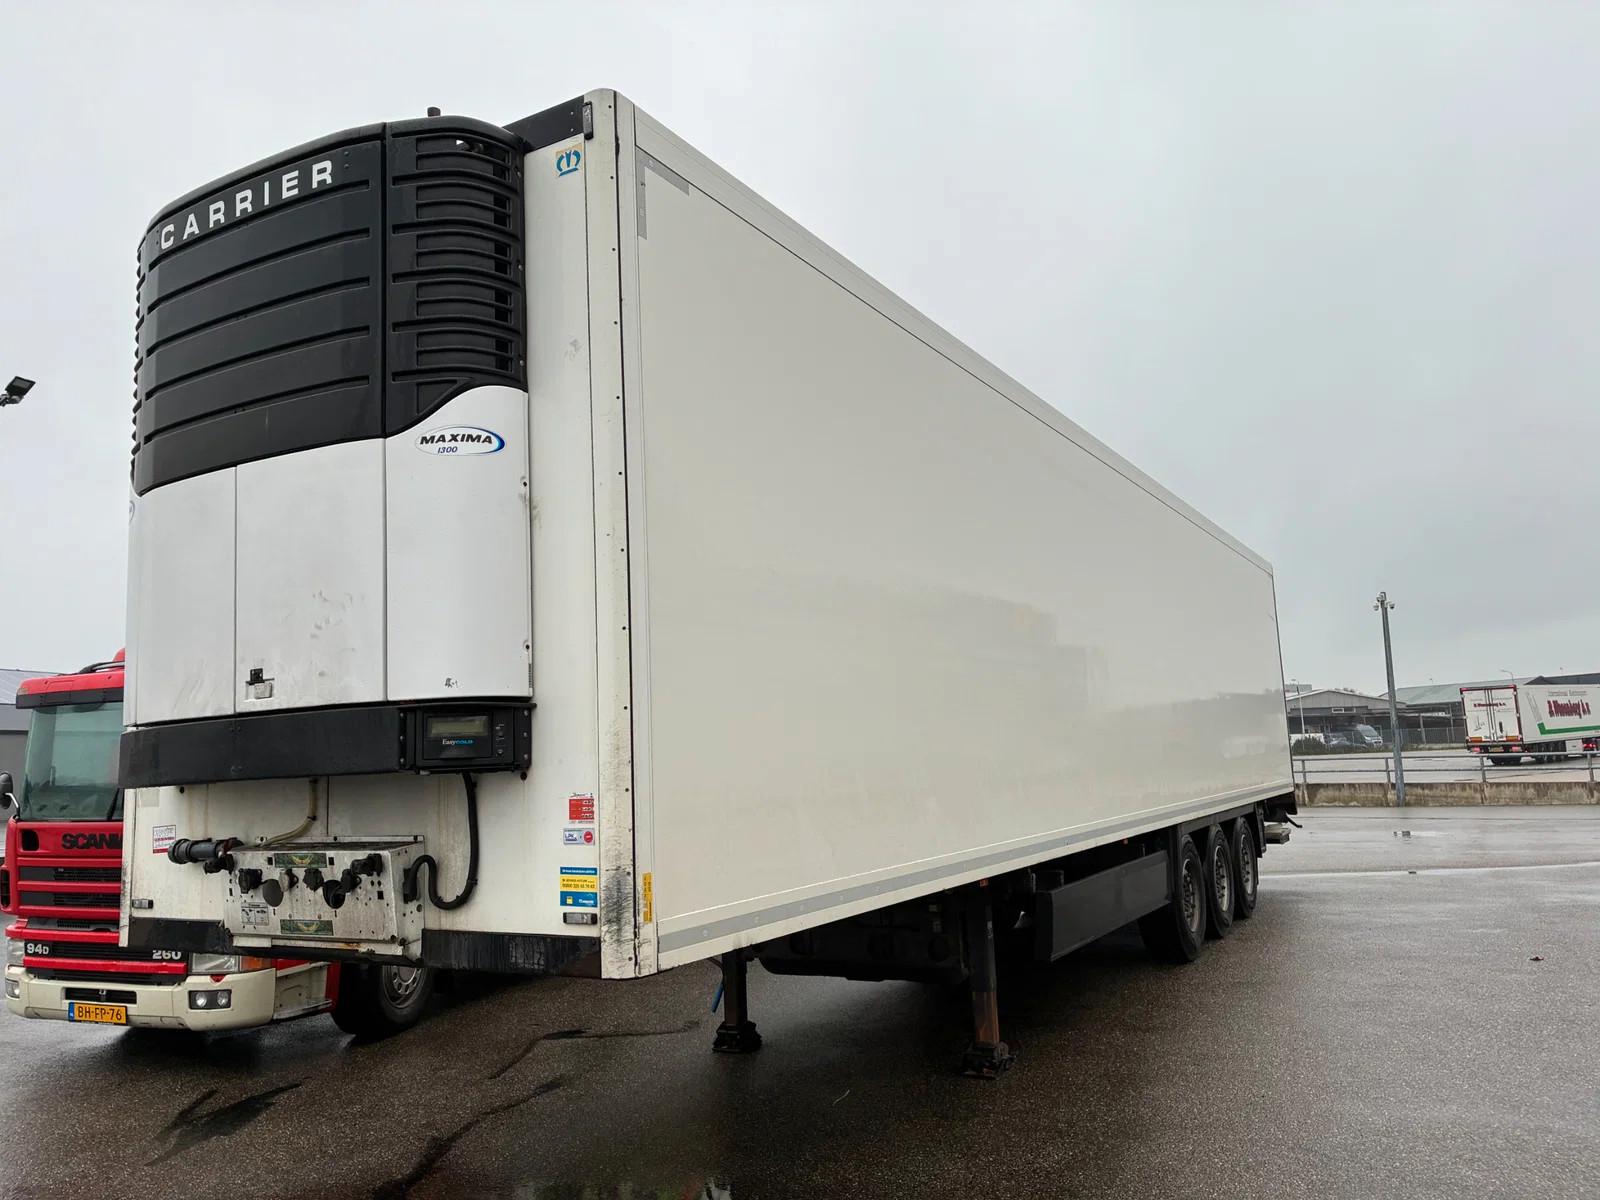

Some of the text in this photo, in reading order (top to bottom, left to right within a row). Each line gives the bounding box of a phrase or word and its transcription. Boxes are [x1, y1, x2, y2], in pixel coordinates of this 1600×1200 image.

[161, 160, 332, 249] CARRIER
[420, 434, 492, 445] MAXIMA
[437, 446, 458, 454] 1300
[26, 943, 49, 955] 94D
[77, 1006, 122, 1021] BH-FP-76
